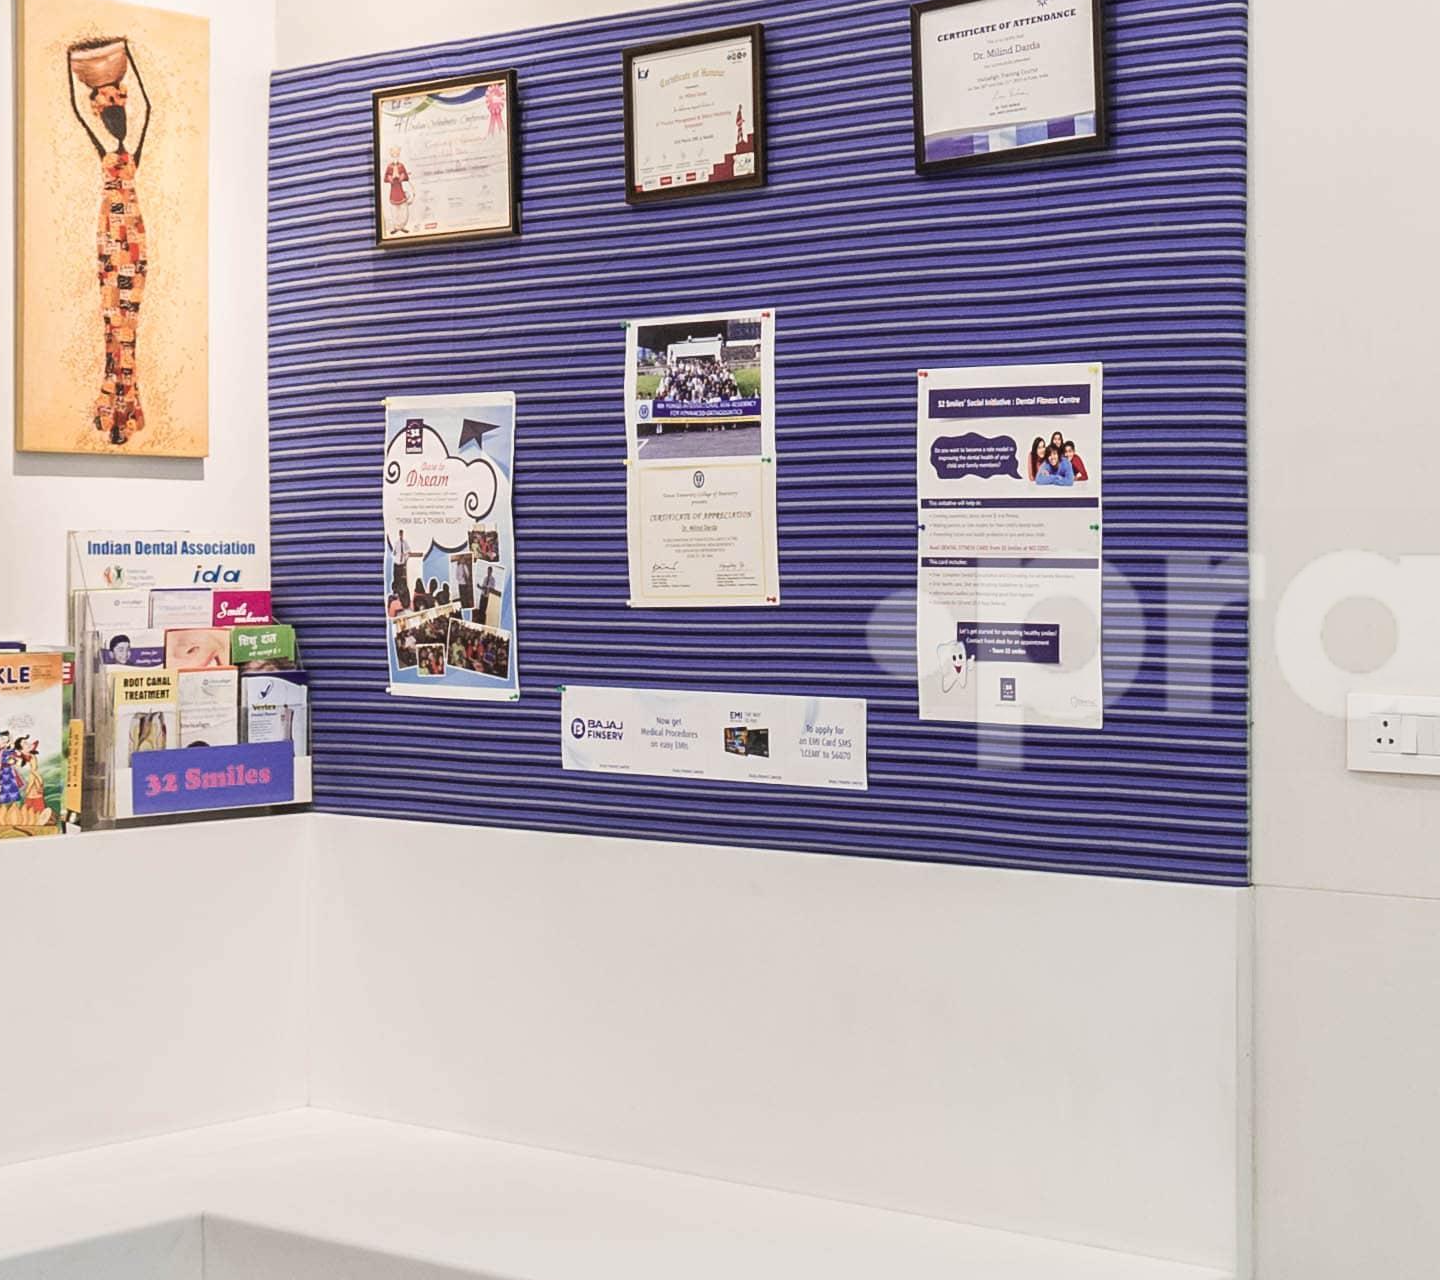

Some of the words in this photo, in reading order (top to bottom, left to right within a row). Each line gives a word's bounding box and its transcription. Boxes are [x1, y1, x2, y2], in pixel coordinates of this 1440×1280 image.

[938, 24, 997, 42] CERTIFICATE
[999, 22, 1011, 31] OF
[1013, 9, 1077, 29] ATTENDANCE
[987, 46, 1013, 59] Milind
[1015, 42, 1041, 53] Darda
[967, 399, 984, 407] Social
[985, 399, 1011, 407] Initiative
[1016, 398, 1035, 406] Dental
[1037, 397, 1058, 405] Fitness
[1060, 396, 1081, 404] Centre
[407, 469, 449, 487] Dream
[650, 513, 691, 522] CERTIFICATE
[693, 512, 702, 520] OF
[702, 511, 752, 520] APPRECIATION
[88, 541, 131, 555] Indian
[135, 541, 177, 555] Dental
[181, 541, 255, 555] Association
[194, 565, 240, 583] ida
[217, 602, 247, 619] Smile
[124, 678, 144, 687] ROOT
[147, 677, 171, 686] CANAL
[125, 690, 170, 700] TREATMENT
[730, 711, 742, 719] EMI
[588, 720, 624, 730] BAJAJ
[657, 717, 669, 725] Now
[671, 718, 682, 726] get
[588, 730, 624, 741] FINSERV
[641, 728, 663, 736] Medical
[665, 729, 698, 739] Procedures
[806, 724, 813, 733] To
[815, 726, 833, 736] apply
[835, 726, 844, 734] for
[660, 742, 673, 751] easy
[675, 741, 688, 750] EMIs
[809, 737, 820, 746] EMI
[822, 738, 836, 747] Card
[838, 739, 851, 747] SMS
[823, 751, 829, 759] to
[145, 773, 178, 797] 32
[185, 764, 271, 791] Smiles
